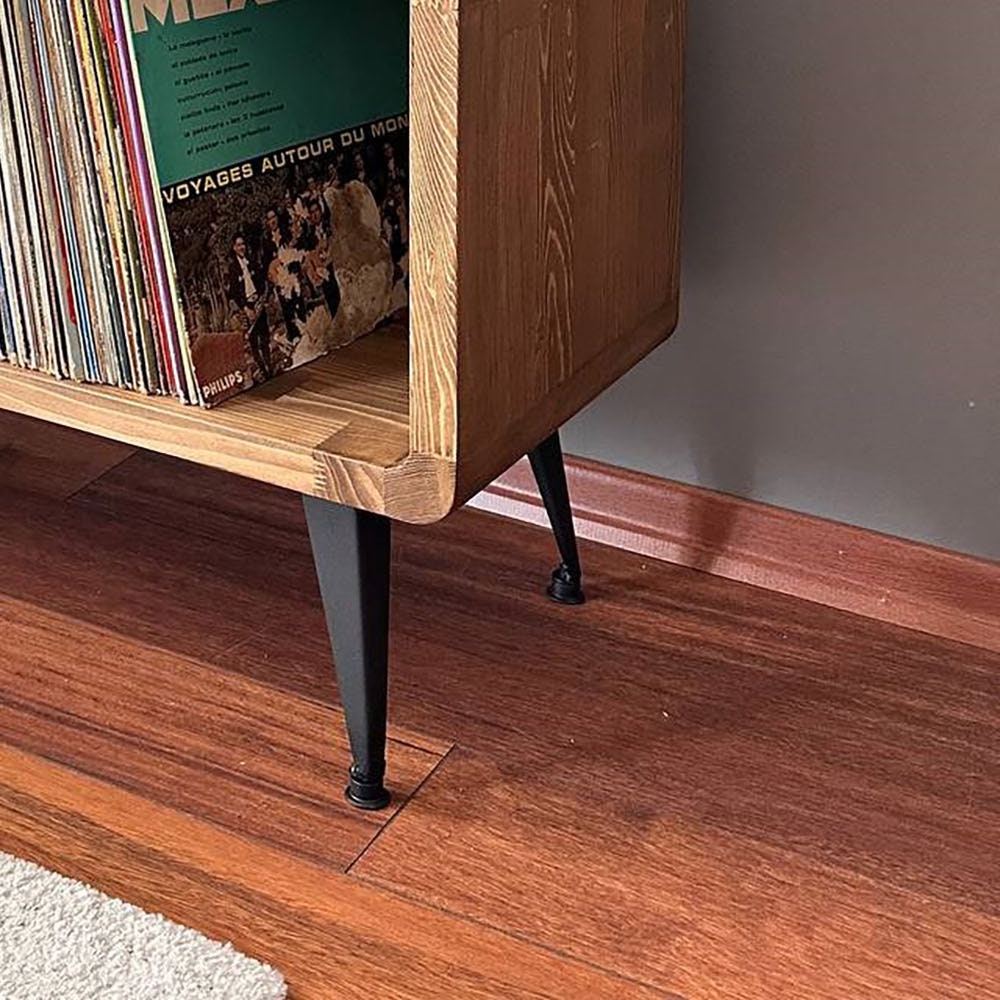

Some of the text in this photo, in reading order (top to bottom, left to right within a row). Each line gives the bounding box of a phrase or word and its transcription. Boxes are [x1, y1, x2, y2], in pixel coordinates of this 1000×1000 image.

[163, 162, 253, 204] VOYAGES
[261, 137, 335, 174] AUTOUR
[341, 127, 366, 147] DU
[203, 370, 244, 397] PHILIPS
